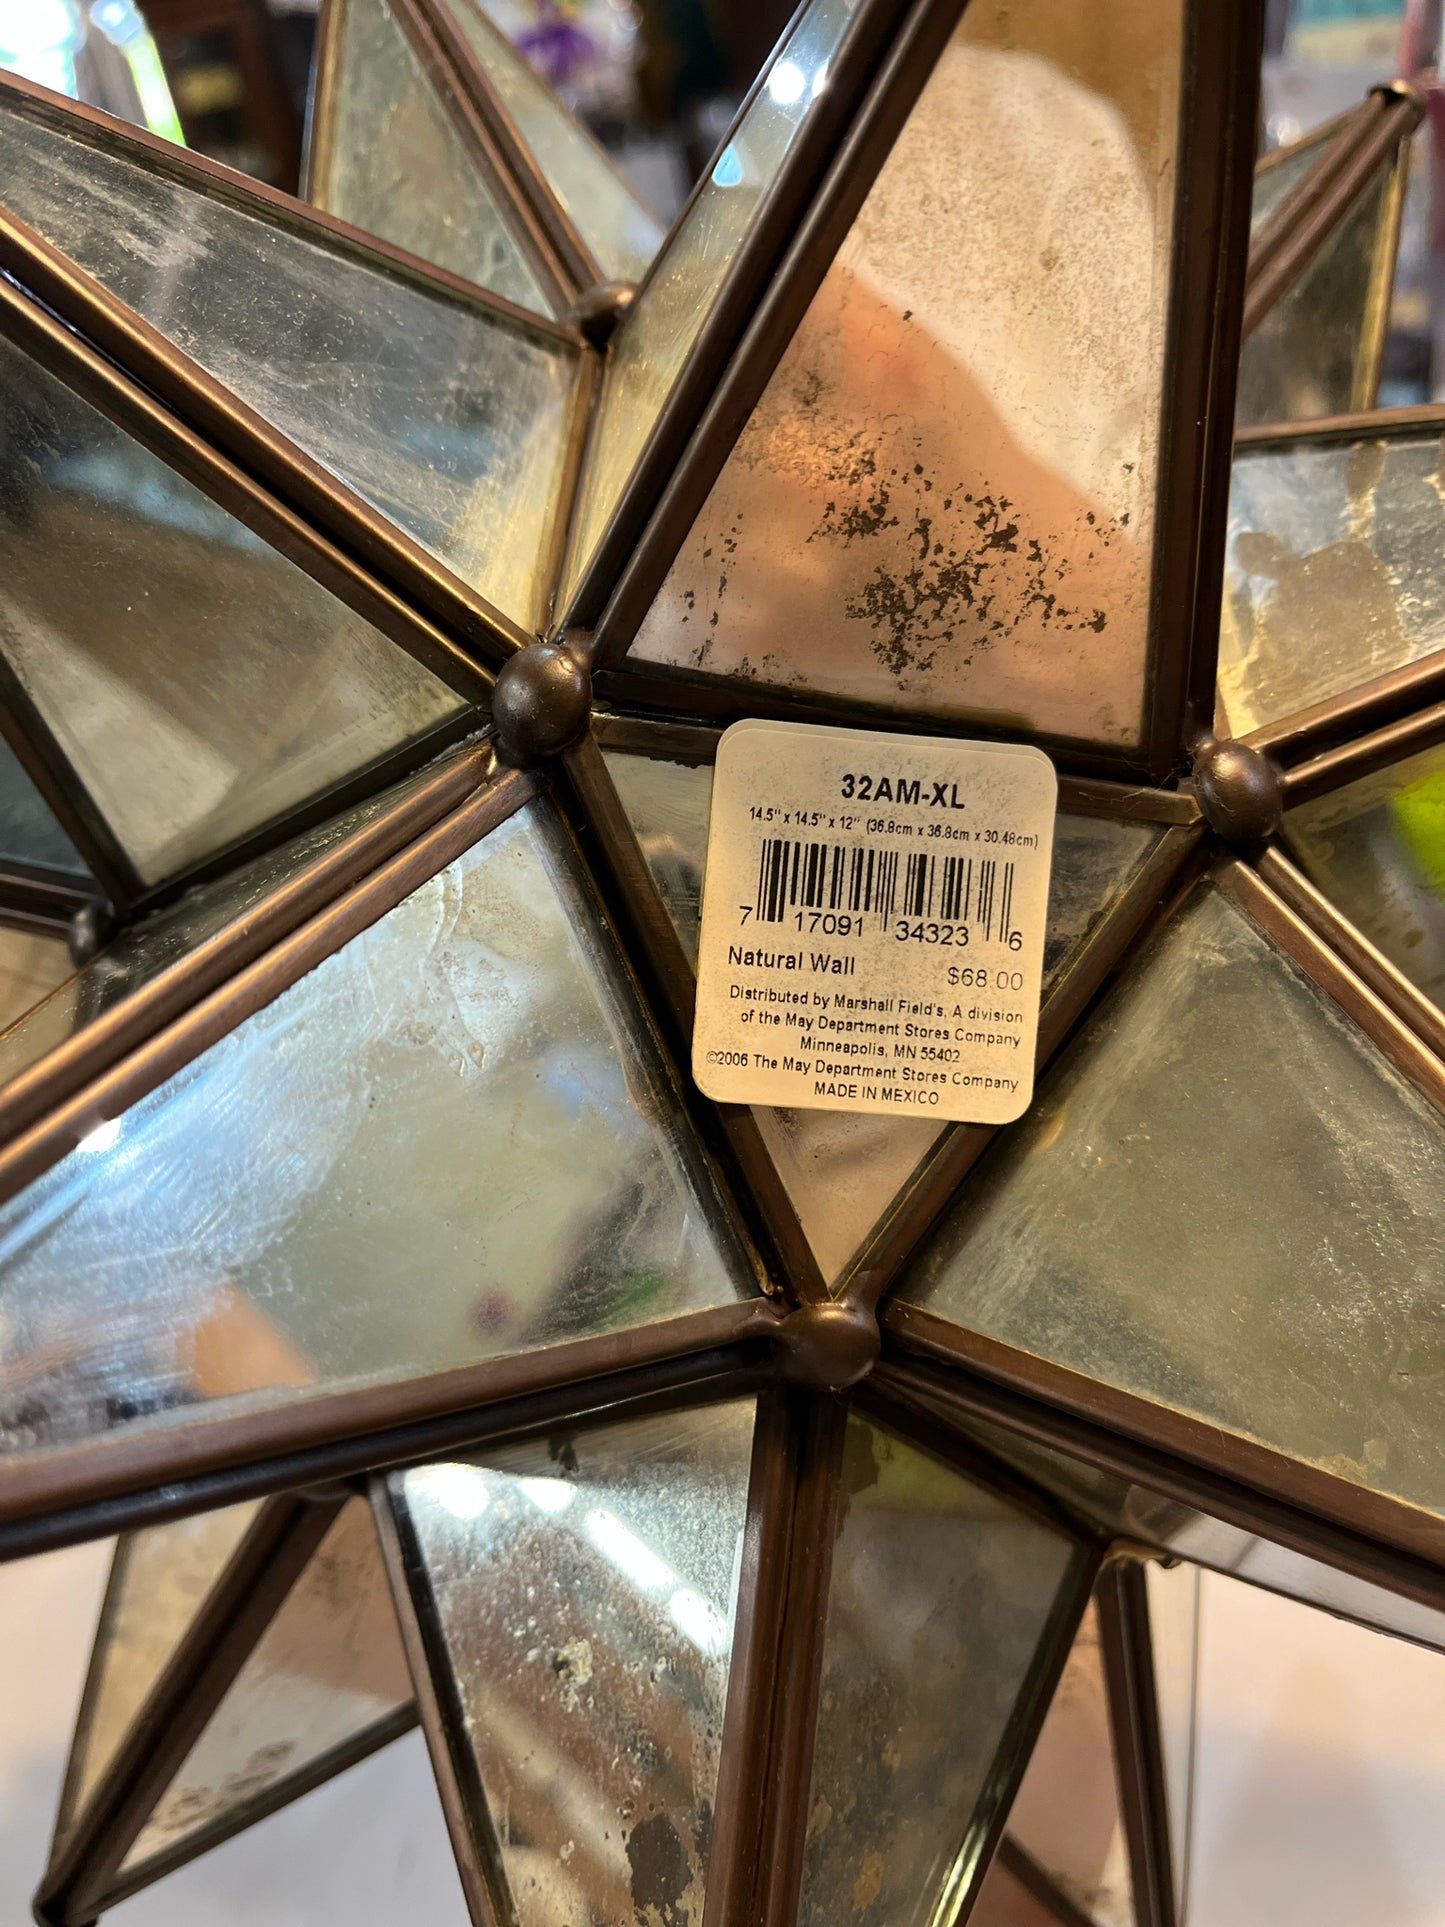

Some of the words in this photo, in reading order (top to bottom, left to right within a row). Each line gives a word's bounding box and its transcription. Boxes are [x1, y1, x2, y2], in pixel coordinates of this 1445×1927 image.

[841, 774, 965, 809] 32AM-XL
[784, 814, 790, 823] x
[828, 818, 835, 829] x
[866, 818, 913, 836] (36.8cm
[917, 826, 924, 836] x
[974, 832, 981, 841] x
[984, 830, 1039, 850] 30.48cm)
[739, 906, 752, 926] 7
[793, 912, 863, 936] 17091
[896, 921, 969, 946] 34323
[1009, 932, 1022, 951] 6
[728, 946, 802, 971] Natural
[810, 951, 855, 975] Wall
[730, 985, 807, 1005] Distributed
[813, 993, 830, 1009] by
[834, 994, 893, 1012] Marshall
[952, 1005, 962, 1018] A
[968, 1006, 1023, 1023] division
[741, 1010, 753, 1023] of
[758, 1012, 780, 1025] the
[785, 1014, 814, 1031] May
[818, 1016, 899, 1038] Department
[905, 1024, 949, 1040] Stores
[955, 1029, 1020, 1049] Company
[894, 1044, 917, 1059] MN
[920, 1047, 961, 1063] 55402
[753, 1055, 777, 1069] The
[783, 1058, 810, 1075] May
[815, 1060, 896, 1081] Department
[902, 1068, 947, 1084] Stores
[952, 1072, 1018, 1092] Company
[814, 1082, 857, 1098] MADE
[862, 1087, 876, 1100] IN
[881, 1087, 939, 1105] MEXICO
